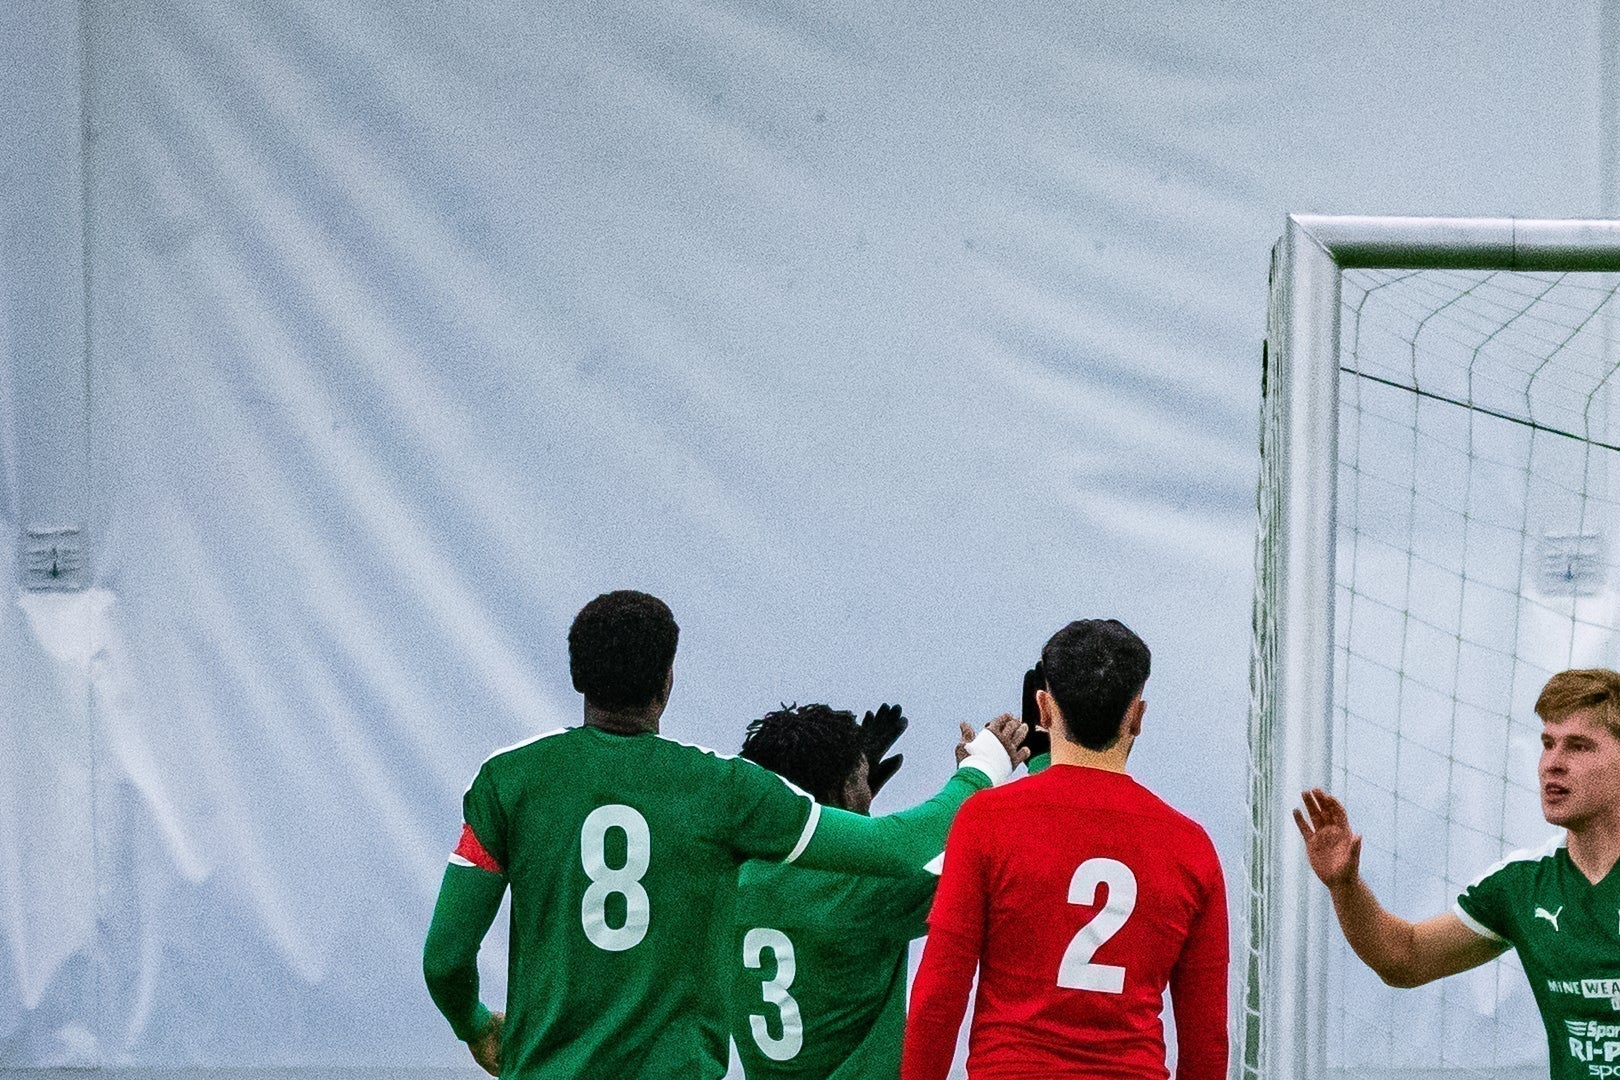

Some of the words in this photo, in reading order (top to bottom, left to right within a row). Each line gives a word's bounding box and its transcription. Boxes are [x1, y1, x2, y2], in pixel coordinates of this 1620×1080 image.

[580, 804, 651, 952] 8
[1057, 857, 1138, 995] 2
[743, 927, 803, 1062] 3
